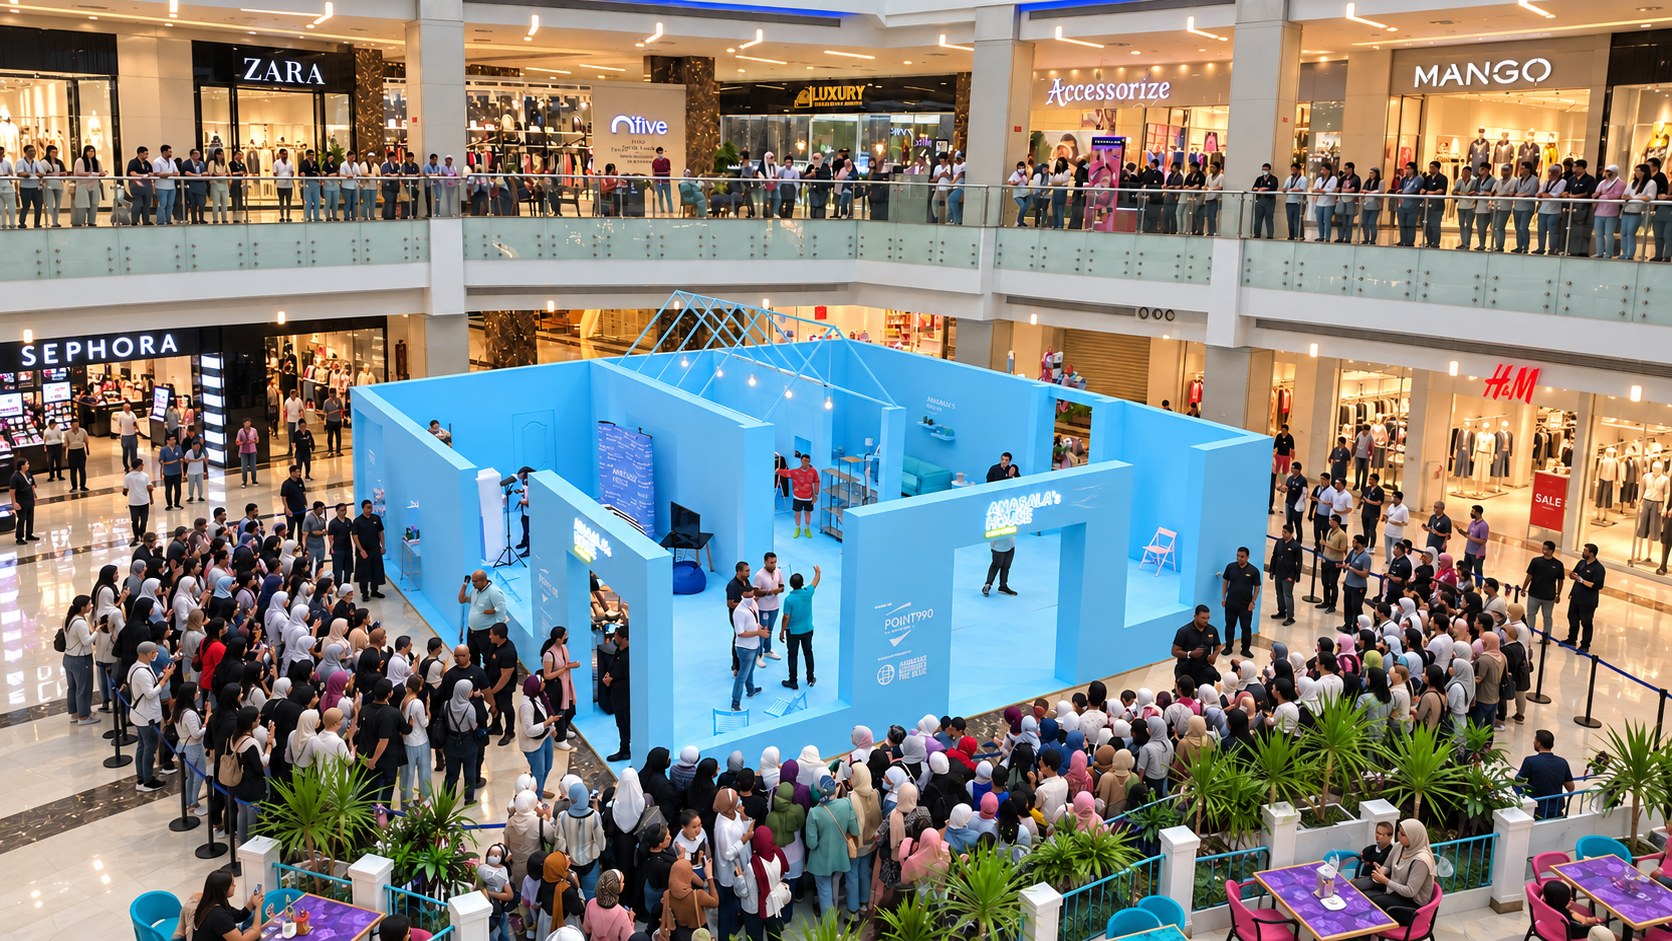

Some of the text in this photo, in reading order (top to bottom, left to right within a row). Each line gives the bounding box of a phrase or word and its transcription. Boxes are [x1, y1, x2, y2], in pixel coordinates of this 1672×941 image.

[244, 57, 326, 84] ZARA
[1414, 58, 1552, 87] MANGO
[812, 86, 866, 100] LUXURY
[1045, 78, 1171, 107] Accessorize
[21, 333, 178, 367] SEPHORA
[1483, 363, 1540, 404] H&M
[1535, 493, 1562, 507] SALE
[884, 608, 934, 630] POINT990
